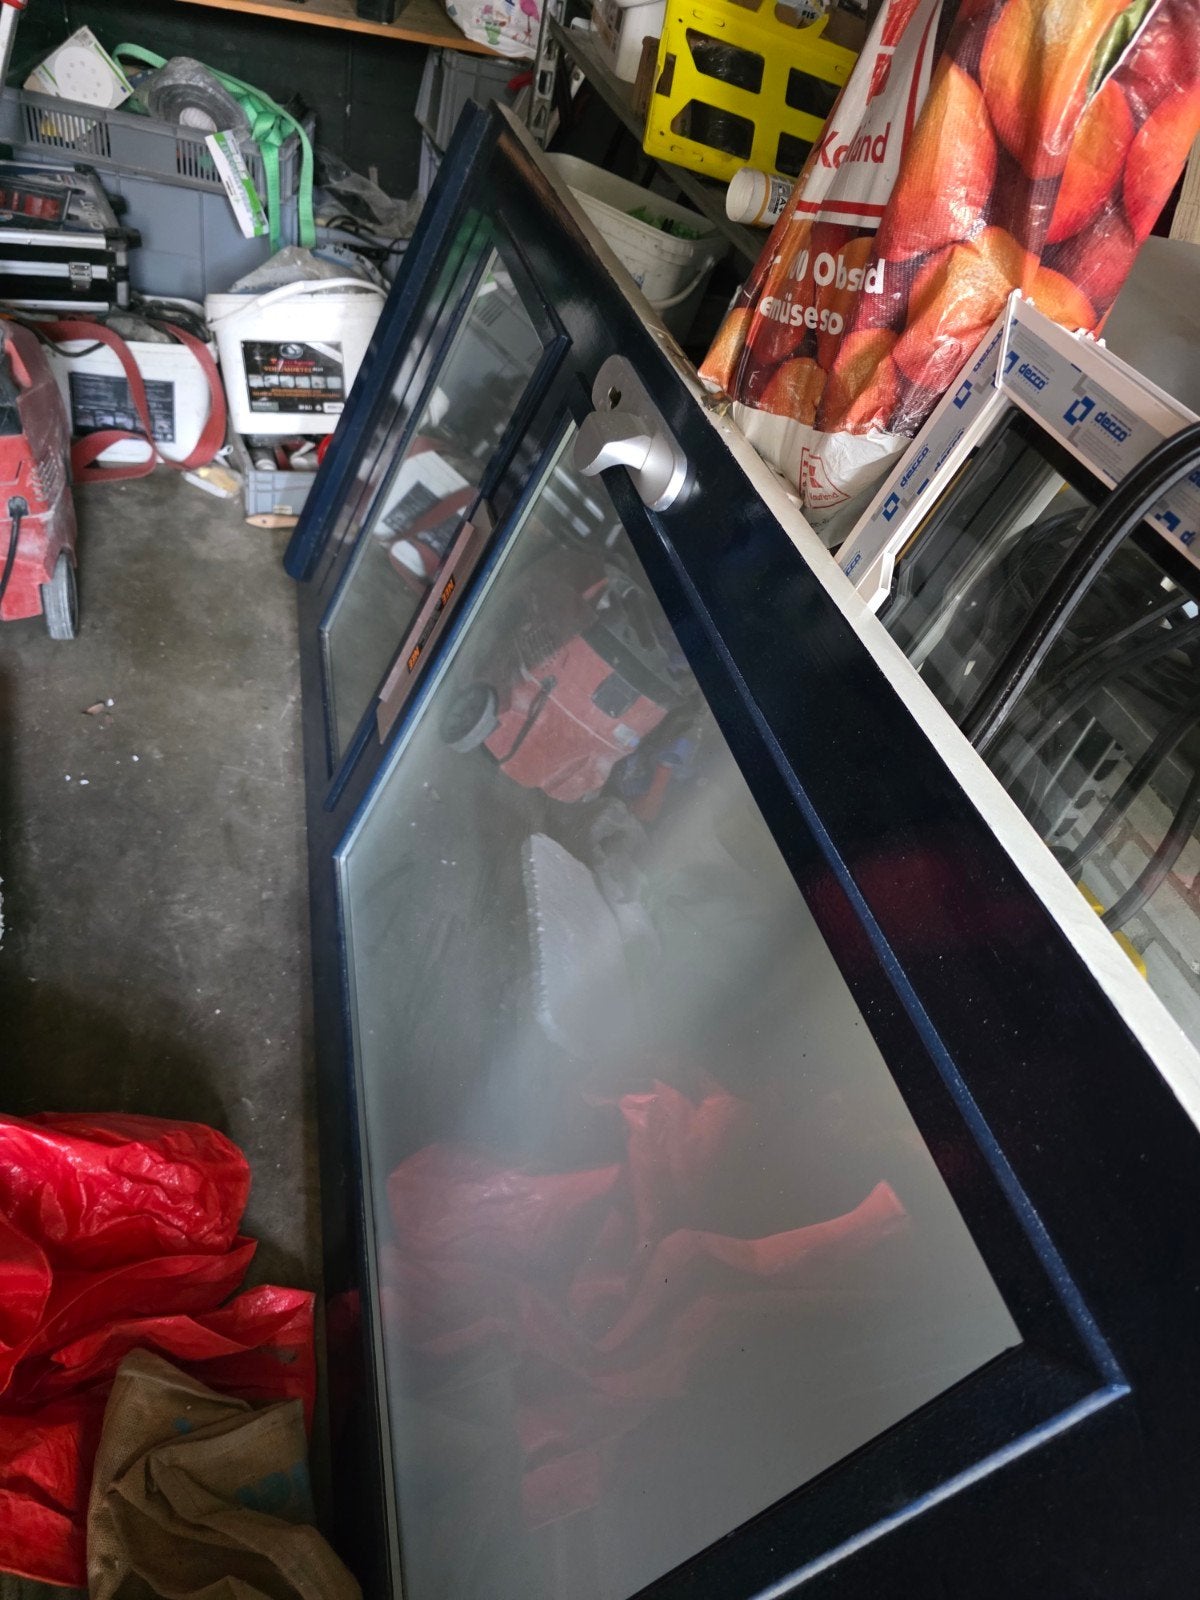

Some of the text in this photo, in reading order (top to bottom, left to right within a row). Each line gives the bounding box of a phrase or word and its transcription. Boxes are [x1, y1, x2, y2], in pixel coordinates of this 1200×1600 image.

[1018, 363, 1047, 391] decco
[1094, 411, 1128, 443] decco
[900, 445, 930, 488] decco
